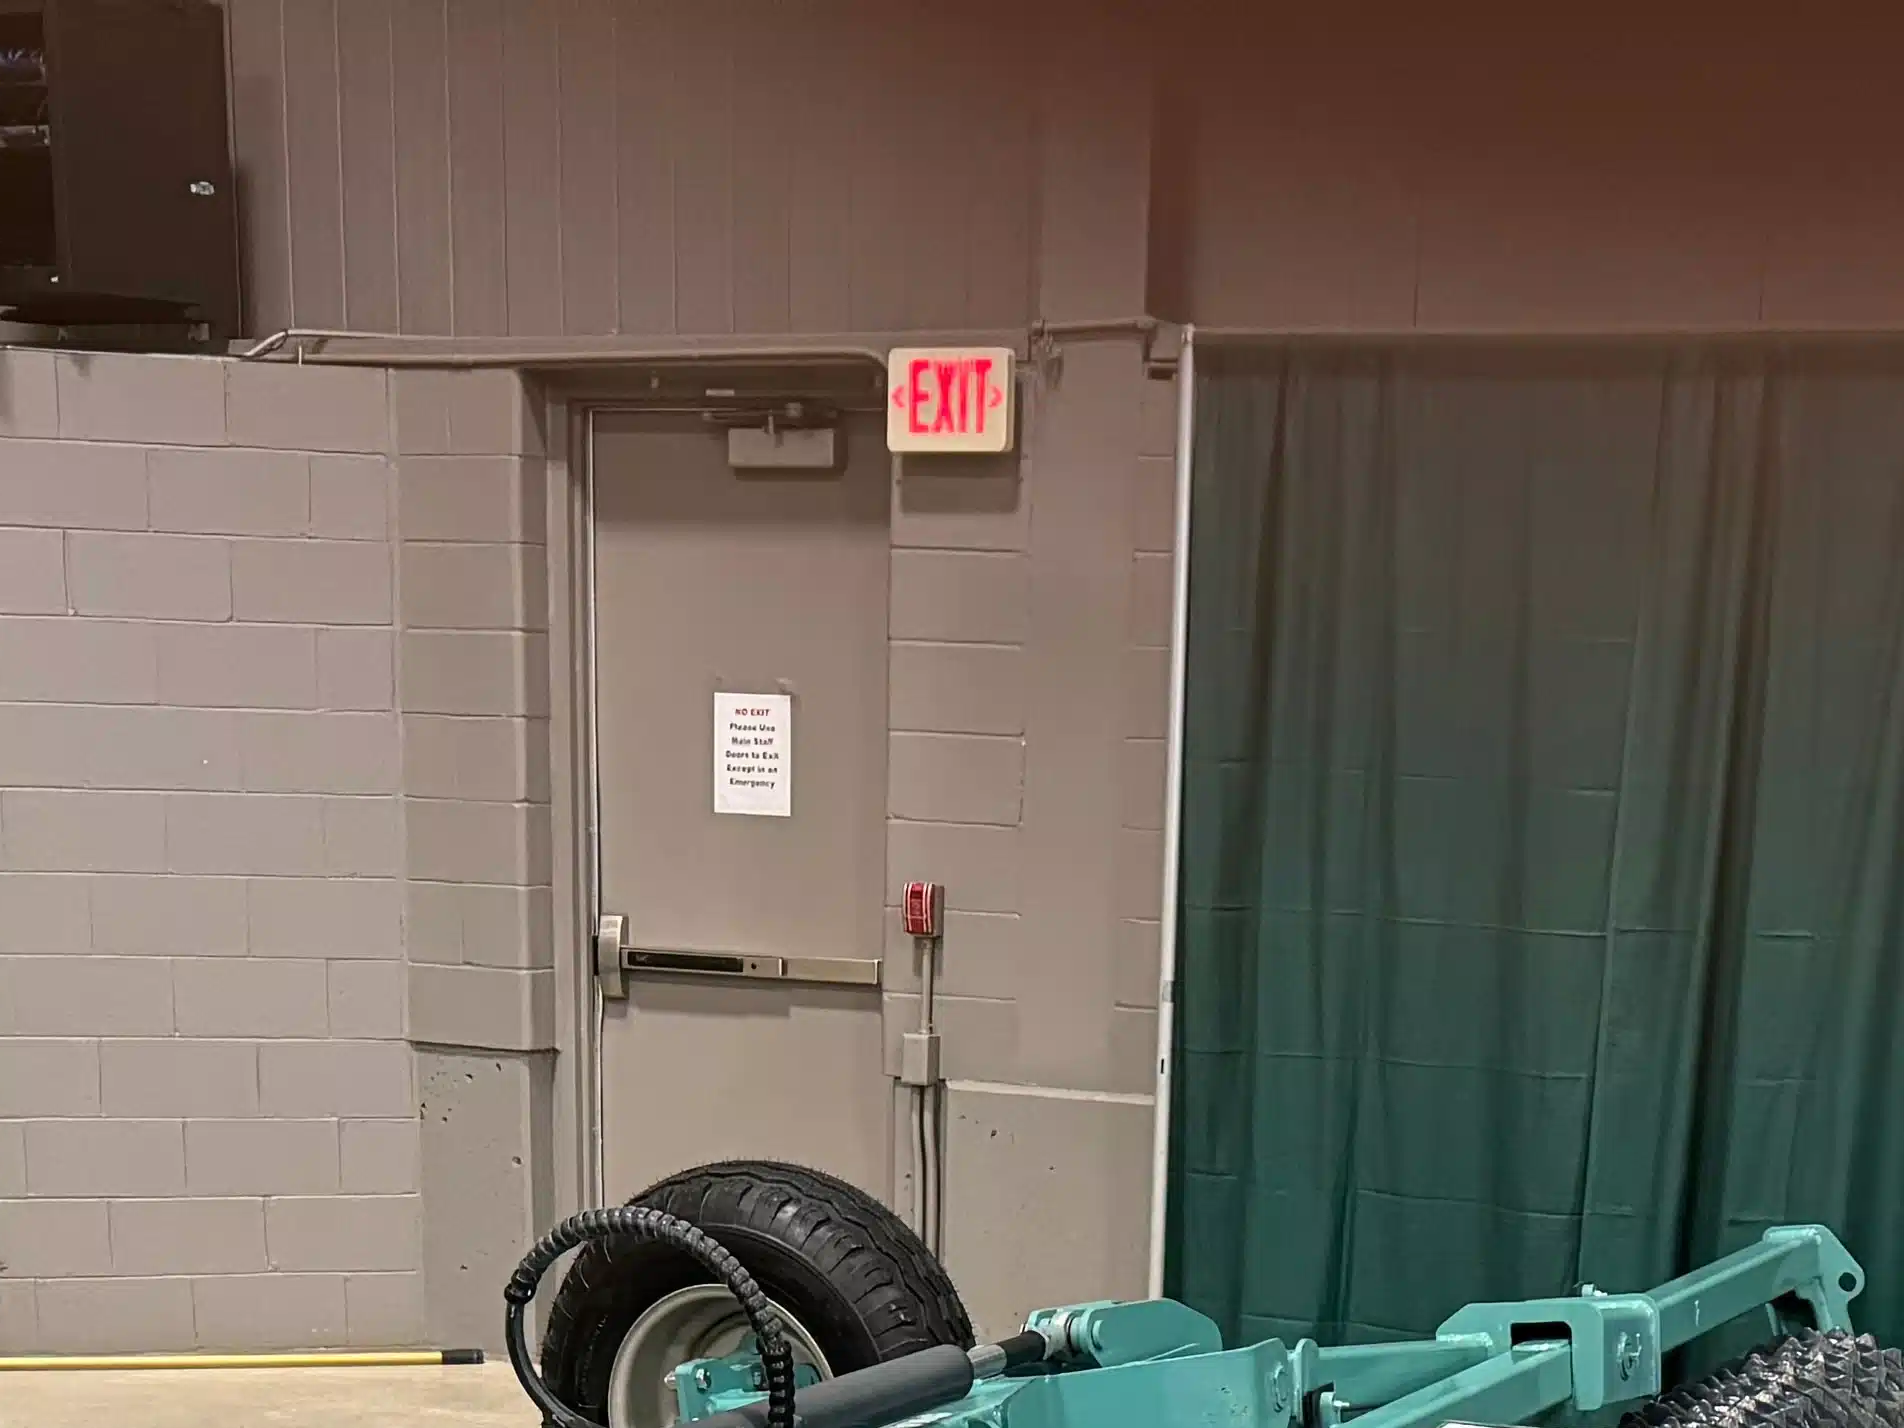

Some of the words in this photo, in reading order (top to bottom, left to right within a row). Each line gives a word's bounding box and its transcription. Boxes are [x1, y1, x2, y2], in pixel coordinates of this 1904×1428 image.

[908, 359, 992, 434] EXIT
[735, 708, 748, 716] NO
[750, 708, 770, 717] EXIT
[729, 722, 757, 731] Please
[759, 724, 776, 732] Use
[731, 736, 751, 745] Main
[754, 737, 774, 746] Staff
[725, 750, 749, 759] Doors
[751, 751, 760, 760] to
[762, 751, 779, 760] Exit
[727, 763, 755, 773] Except
[757, 765, 765, 773] in
[729, 777, 776, 789] Emergency
